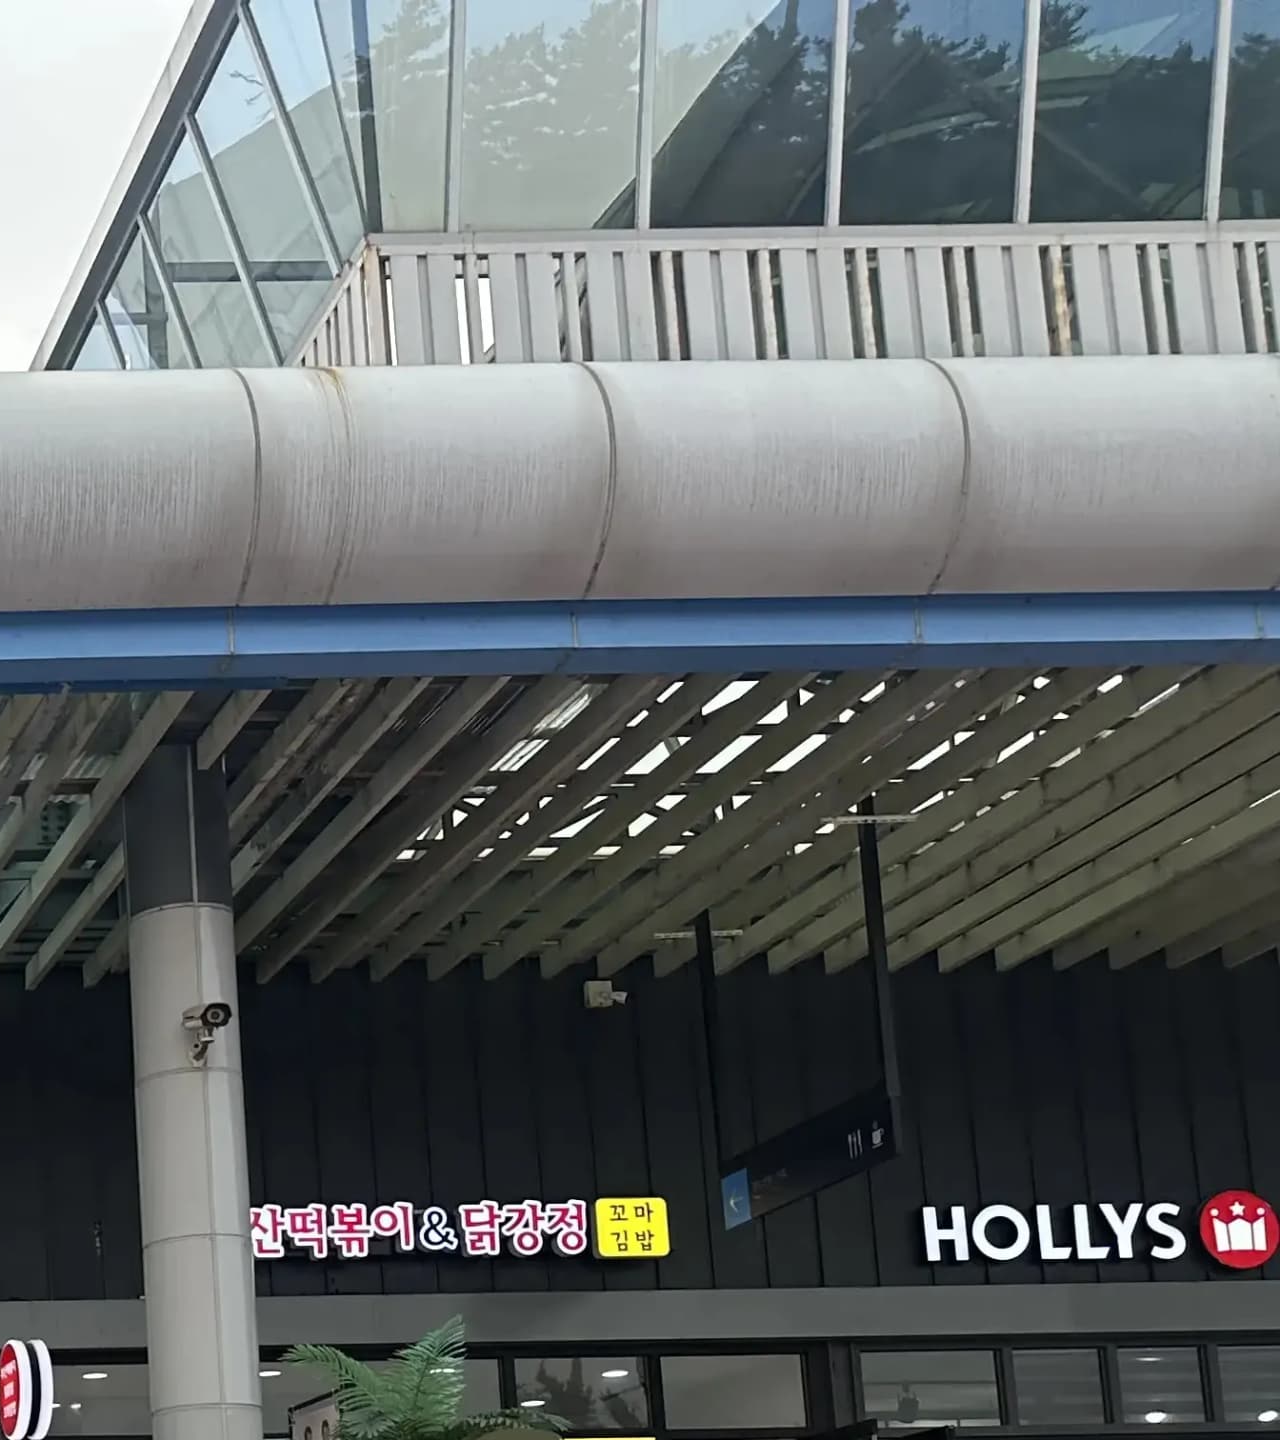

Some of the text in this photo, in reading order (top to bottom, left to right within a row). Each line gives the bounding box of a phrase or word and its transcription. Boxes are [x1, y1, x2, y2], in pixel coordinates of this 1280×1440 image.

[460, 1201, 587, 1255] 닭강정
[608, 1203, 653, 1223] 꼬마
[609, 1230, 654, 1252] 김밥
[923, 1204, 1187, 1261] HOLLYS
